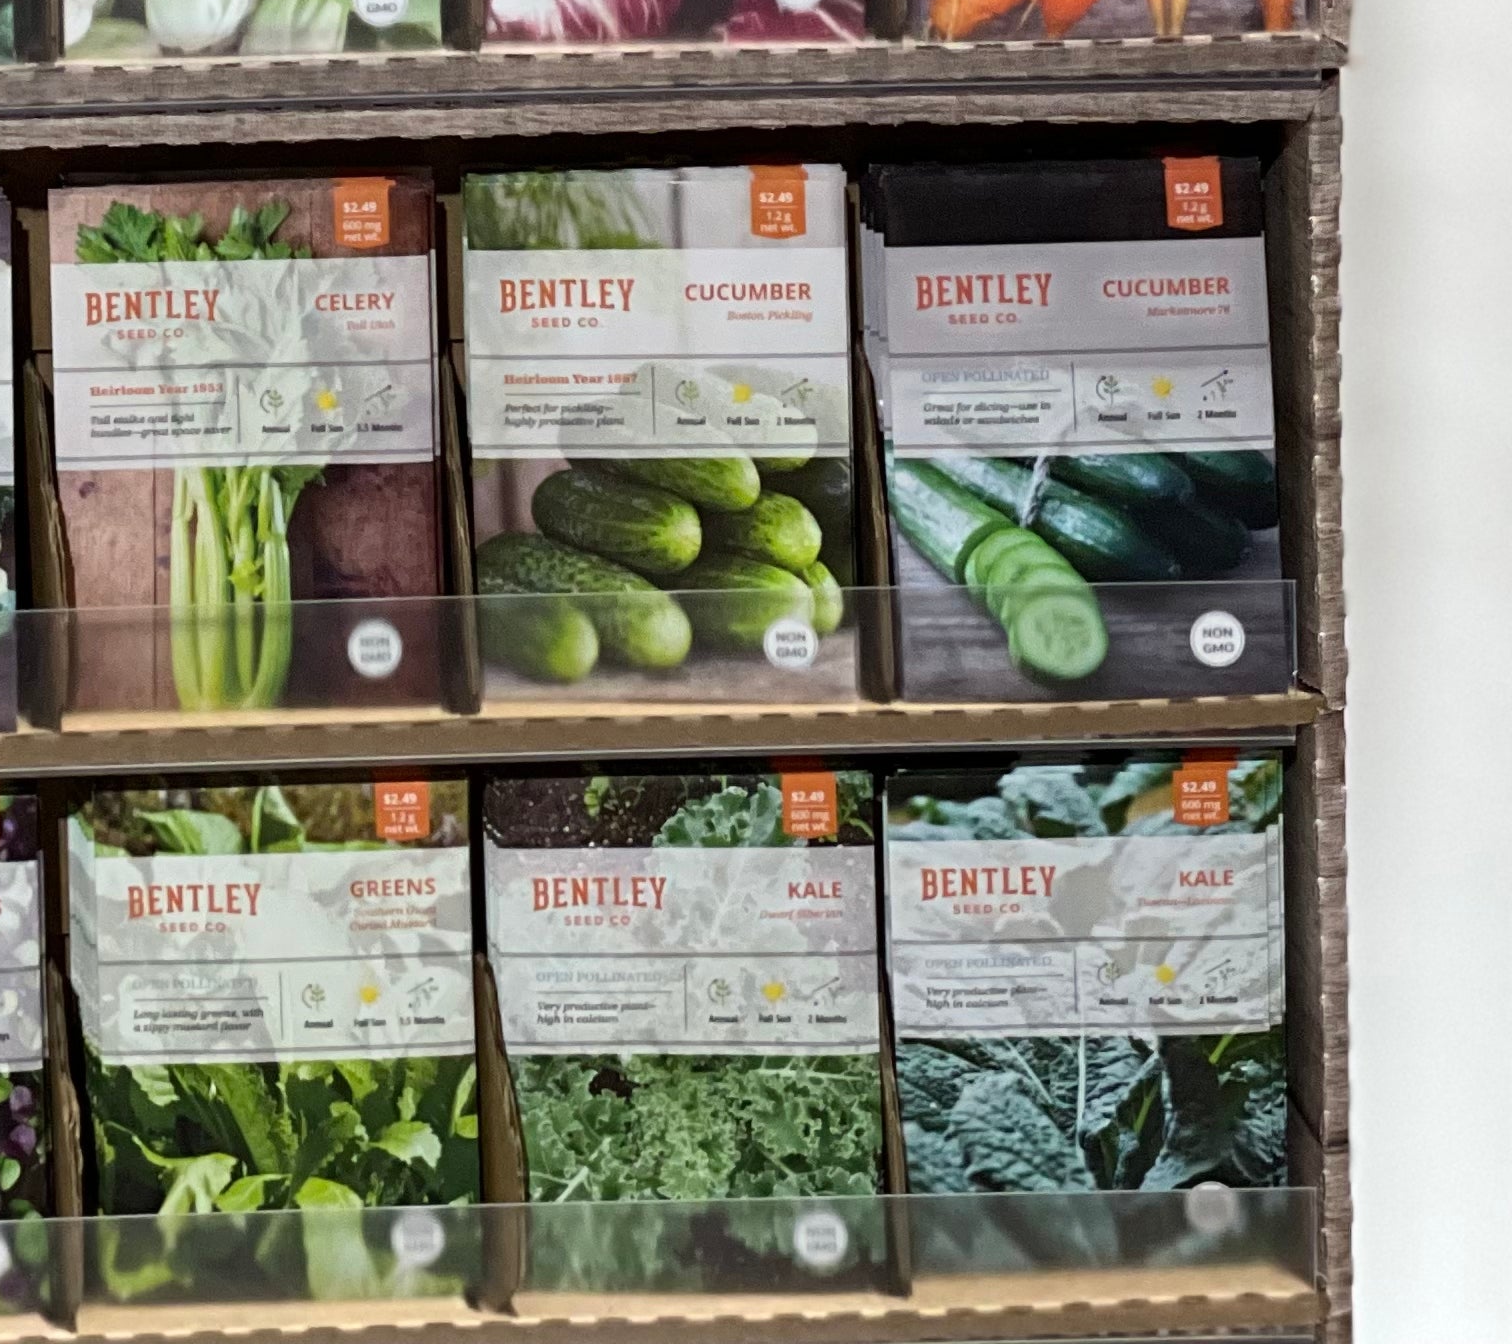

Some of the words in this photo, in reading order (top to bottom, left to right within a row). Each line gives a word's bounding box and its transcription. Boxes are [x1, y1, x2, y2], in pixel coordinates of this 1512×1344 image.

[760, 192, 793, 203] $2.49
[1175, 183, 1208, 194] $2.49
[343, 202, 376, 213] $2.49
[500, 279, 634, 313] BENTLEY
[685, 283, 811, 301] CUCUMBER
[916, 273, 1052, 310] BENTLEY
[1103, 277, 1229, 298] CUCUMBER
[86, 289, 219, 325] BENTLEY
[315, 293, 394, 312] CELERY
[532, 317, 570, 328] SEED
[948, 313, 989, 324] SEED
[117, 329, 156, 341] SEED
[1182, 781, 1216, 792] $2.49
[384, 793, 417, 804] $2.49
[792, 791, 824, 802] $2.49
[922, 866, 1055, 901] BENTLEY
[1180, 869, 1233, 887] KALE
[350, 878, 435, 899] GREENS
[533, 877, 665, 910] BENTLEY
[788, 881, 842, 899] KALE
[128, 883, 261, 920] BENTLEY
[954, 904, 993, 914] SEED
